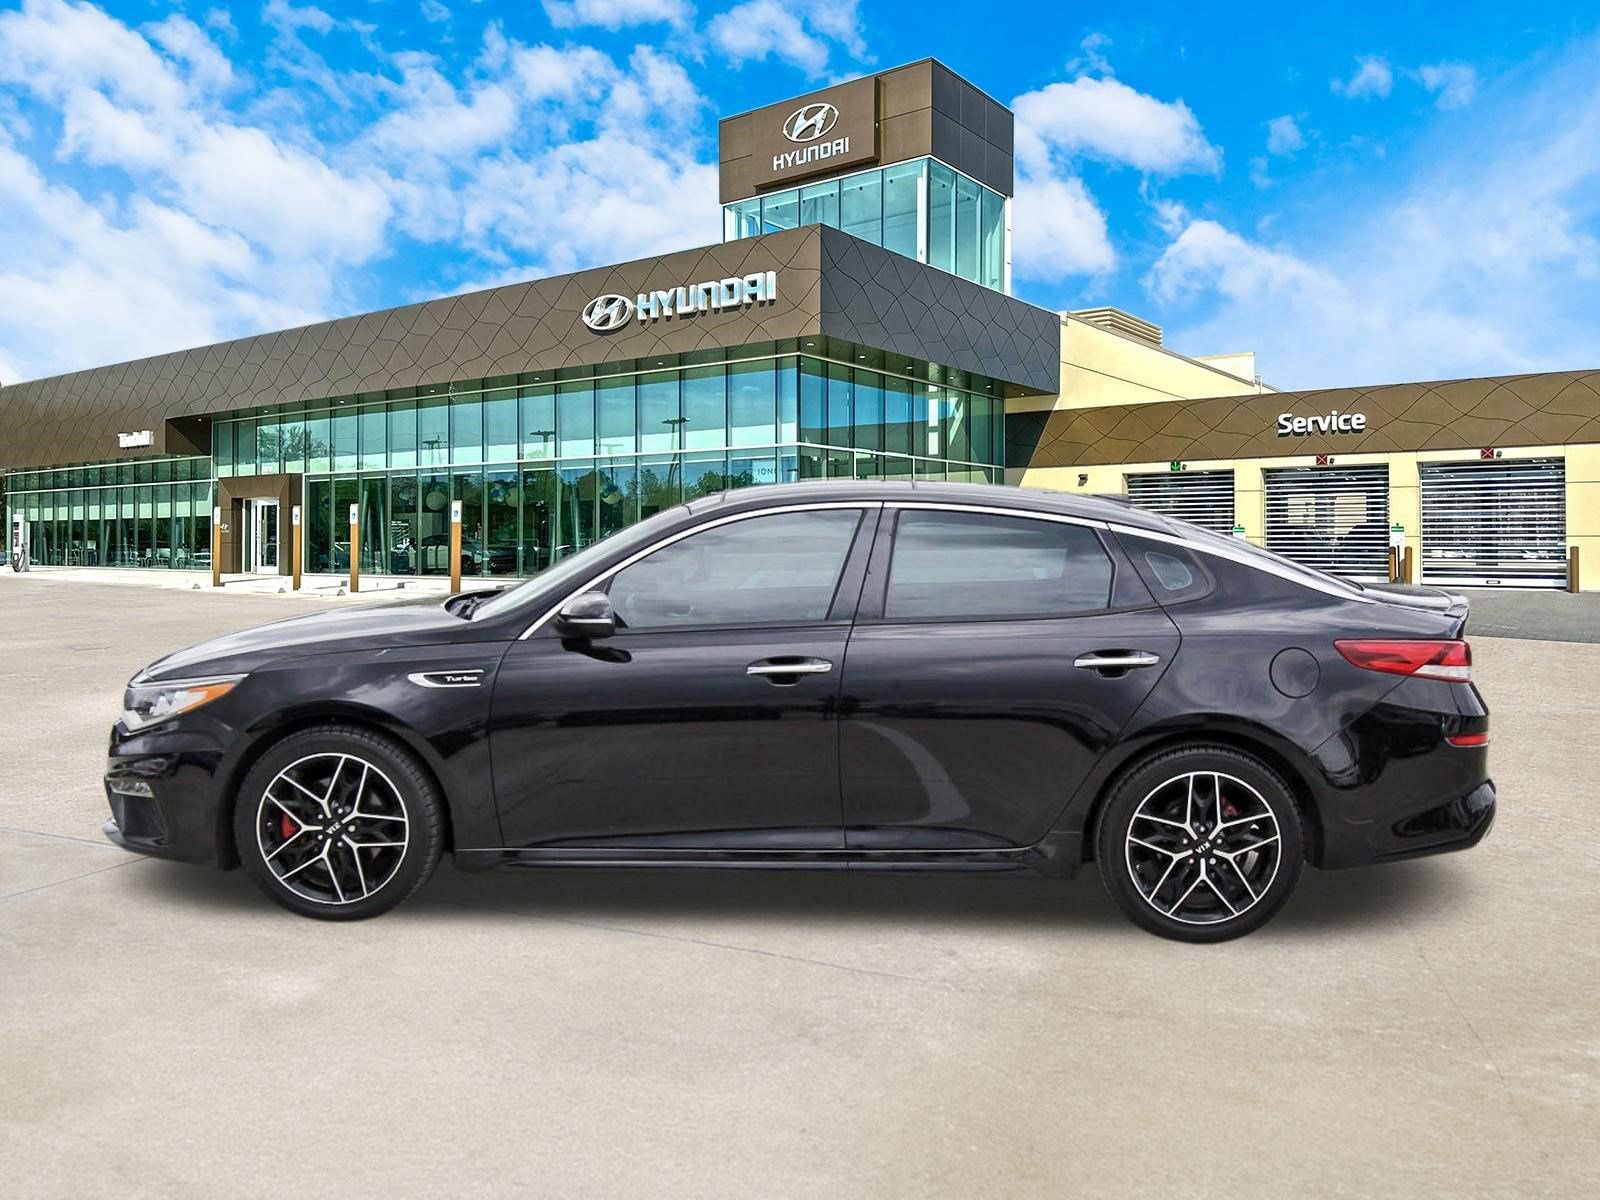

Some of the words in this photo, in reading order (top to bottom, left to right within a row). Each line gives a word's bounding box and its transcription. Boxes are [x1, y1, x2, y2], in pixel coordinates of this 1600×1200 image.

[773, 136, 849, 171] HYUNDAI
[637, 270, 776, 320] HYUNDAI
[1277, 410, 1366, 434] Service
[1195, 841, 1211, 854] KIA
